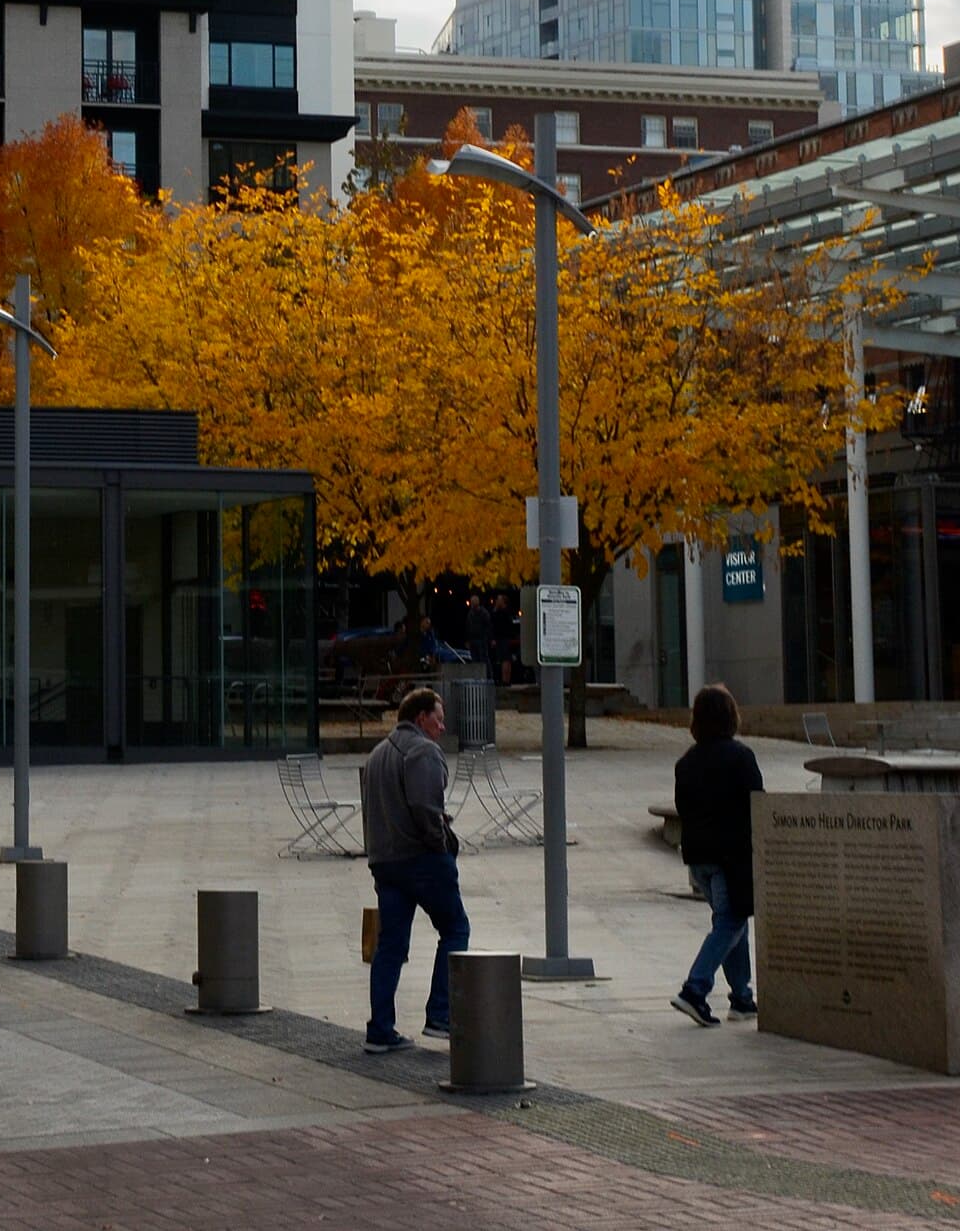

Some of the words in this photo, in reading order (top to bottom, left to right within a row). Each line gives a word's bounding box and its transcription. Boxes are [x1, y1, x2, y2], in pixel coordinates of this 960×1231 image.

[725, 569, 756, 586] CENTER
[772, 811, 798, 828] SIMON
[800, 815, 816, 828] AND
[818, 812, 844, 830] HELEN
[846, 812, 888, 831] DIRECTOR
[889, 813, 913, 832] PARK
